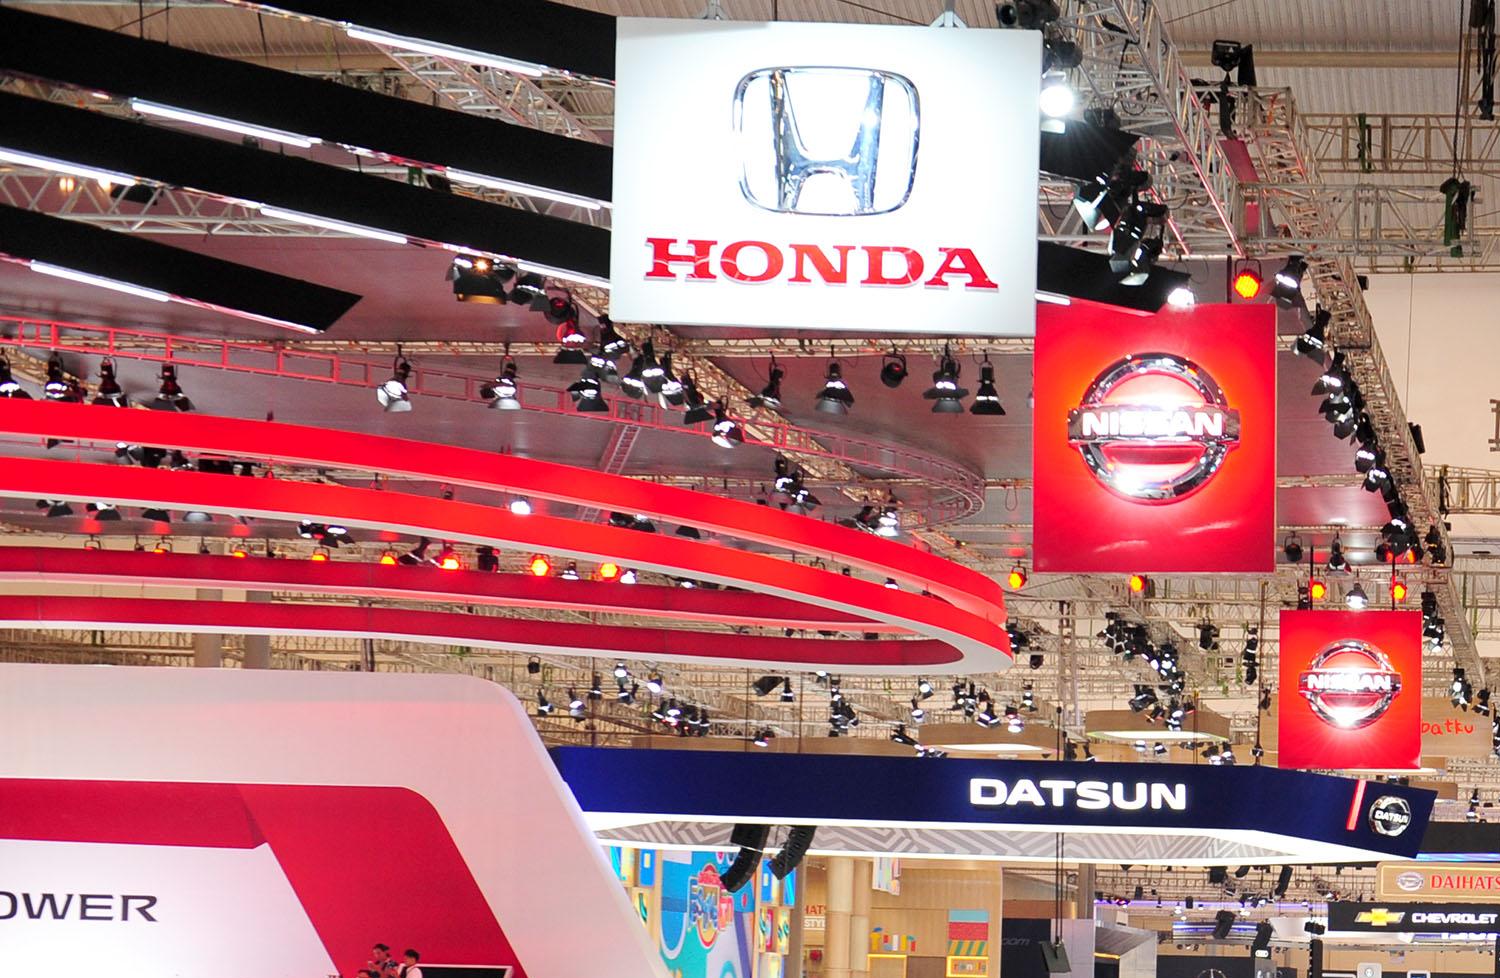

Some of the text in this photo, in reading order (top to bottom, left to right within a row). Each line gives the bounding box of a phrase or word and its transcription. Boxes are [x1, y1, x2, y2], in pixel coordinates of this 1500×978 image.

[644, 237, 1000, 290] HONDA
[1082, 411, 1223, 437] NISSAN
[968, 778, 1187, 811] DATSUN
[1411, 911, 1499, 925] CHEVROLET
